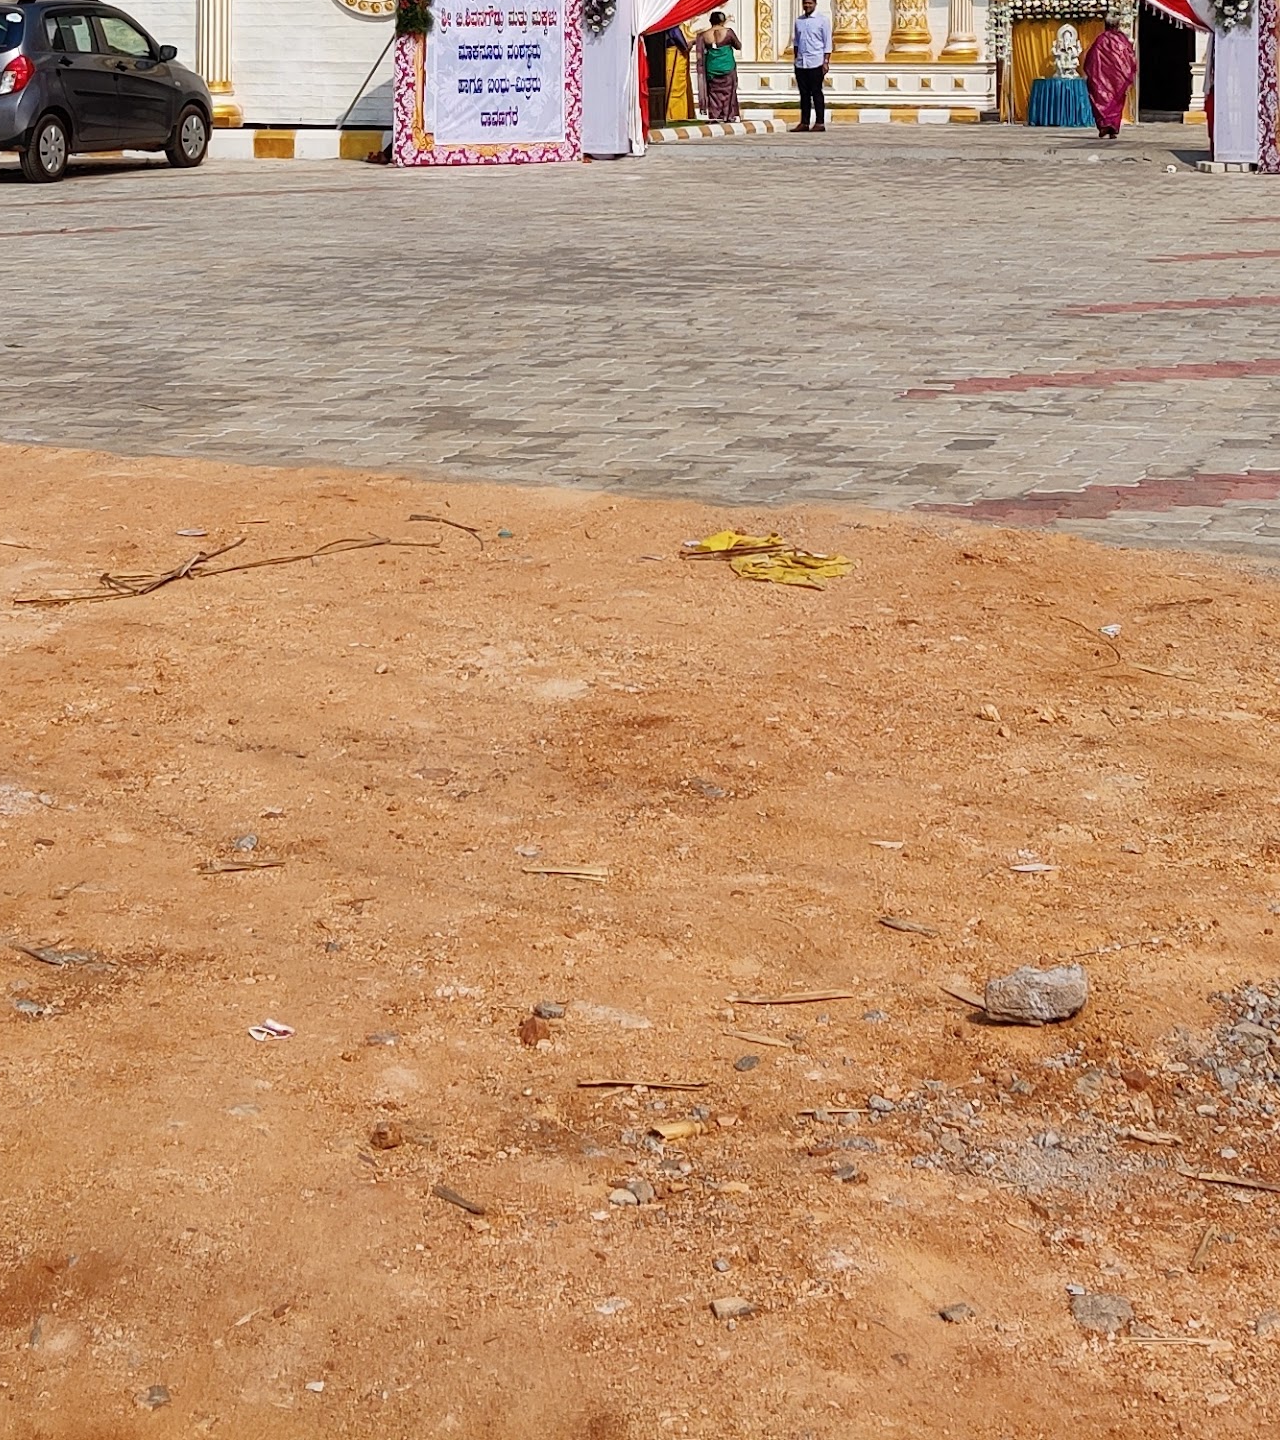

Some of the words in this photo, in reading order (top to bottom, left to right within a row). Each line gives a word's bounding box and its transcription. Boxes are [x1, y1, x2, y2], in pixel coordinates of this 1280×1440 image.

[440, 7, 452, 34] ಶ್ರೀ
[508, 8, 528, 34] ಮತ್ತು
[531, 8, 557, 36] ಮಕ್ಕಳು
[458, 74, 483, 94] ಹಾಗೂ
[481, 106, 518, 127] ದಾವಣಗೆರೆ
